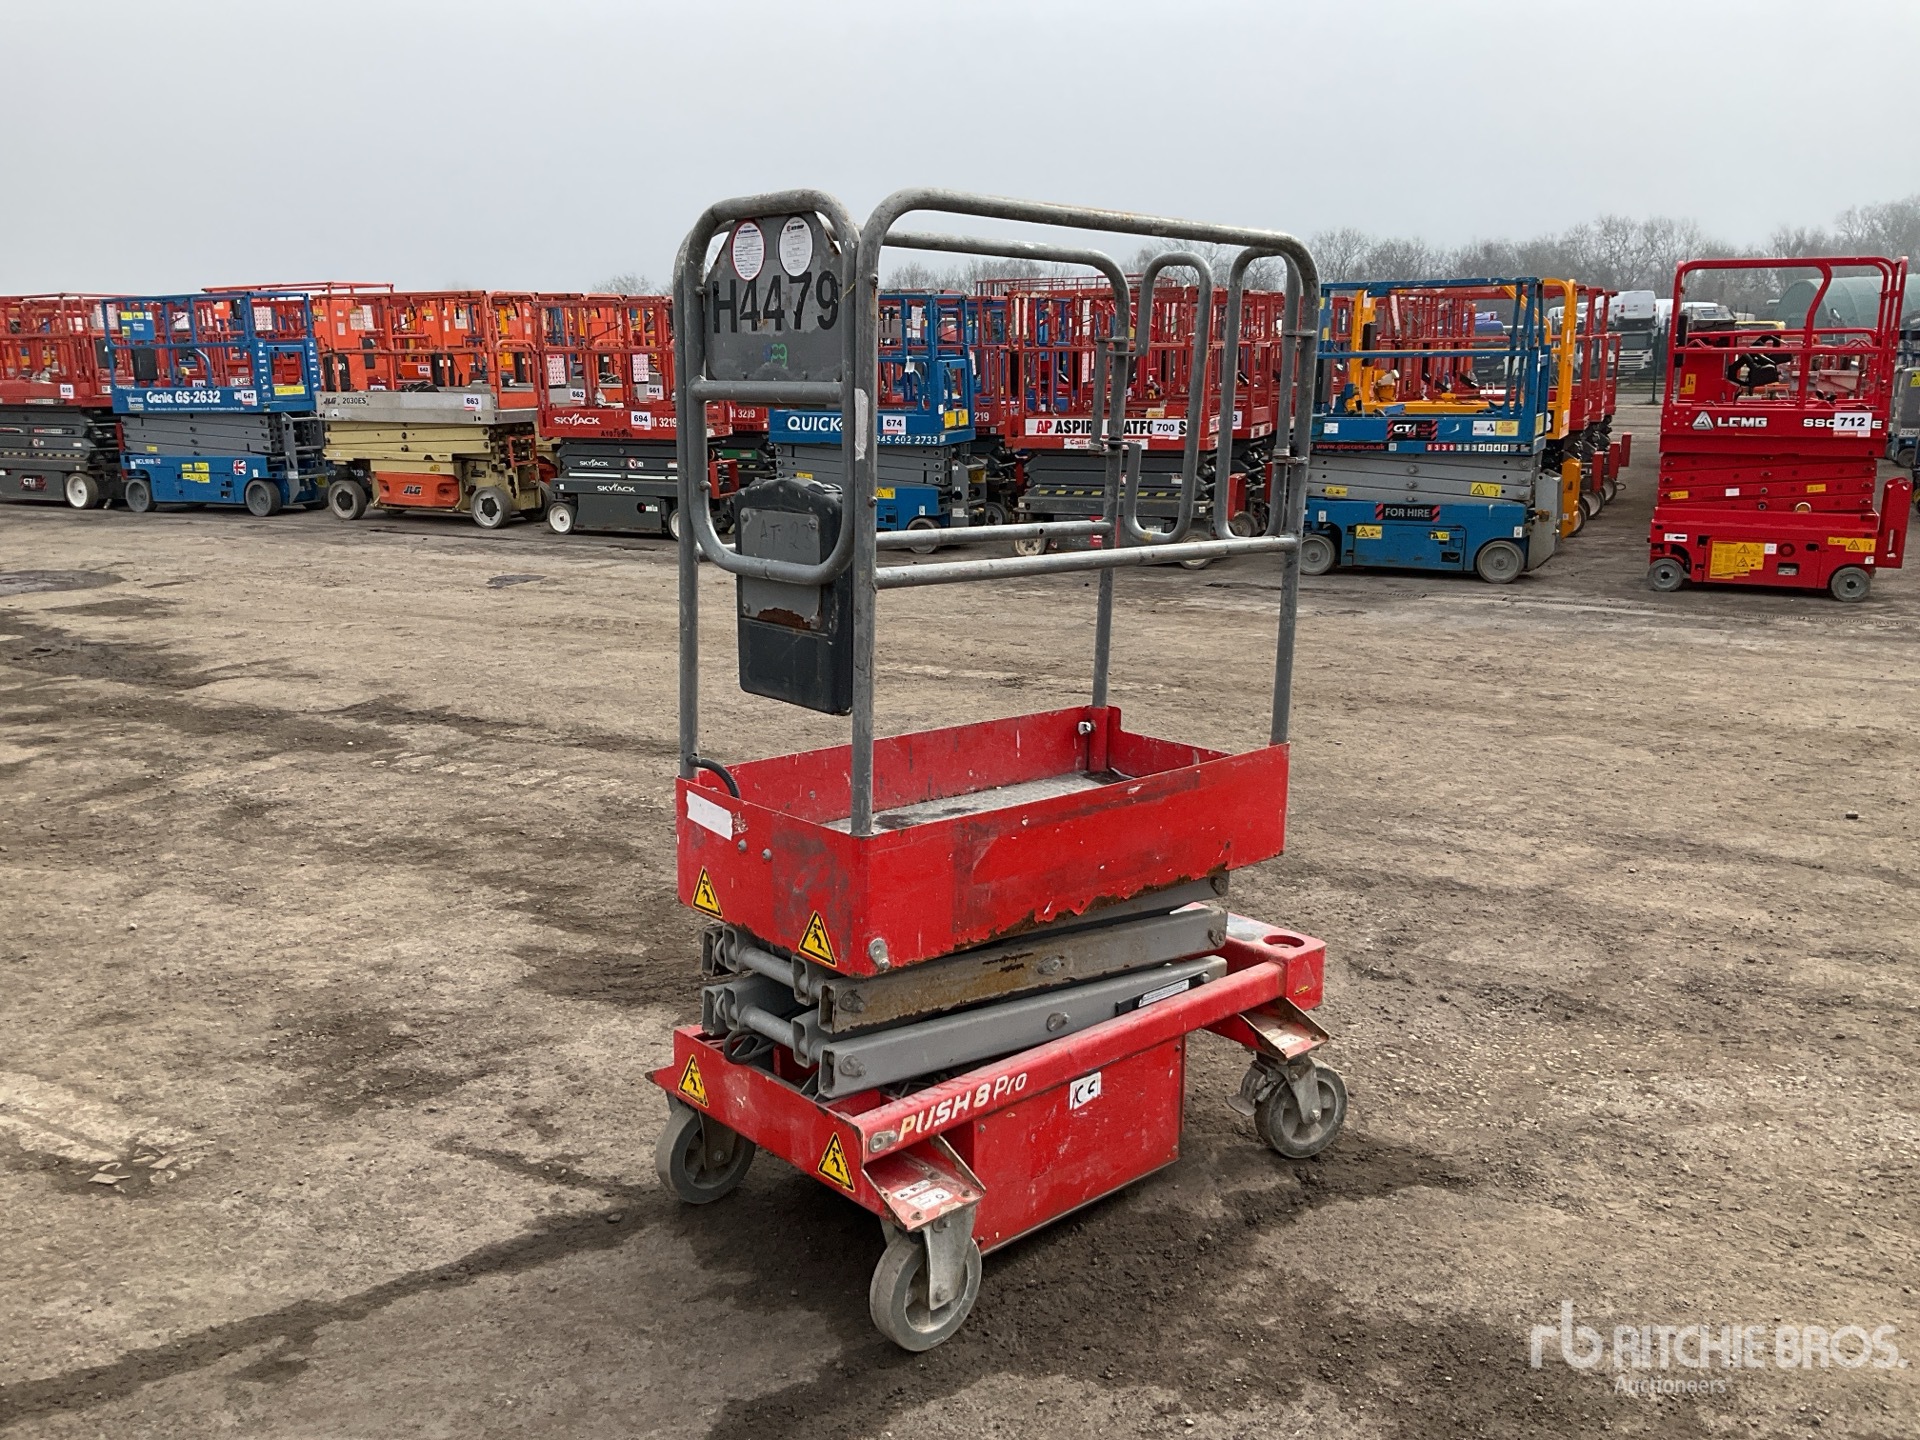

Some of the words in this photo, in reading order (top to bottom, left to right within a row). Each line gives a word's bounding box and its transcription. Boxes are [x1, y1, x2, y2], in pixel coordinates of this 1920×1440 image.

[712, 271, 838, 334] H4479
[146, 391, 173, 404] Genie
[175, 390, 221, 404] GS-2632
[323, 397, 337, 405] JLG
[466, 397, 479, 405] 663
[553, 413, 600, 425] SKYJACK
[633, 414, 648, 423] 694
[659, 417, 677, 427] 3219
[974, 412, 990, 422] 219
[1839, 417, 1866, 427] 712
[787, 415, 843, 432] QUICK
[886, 419, 902, 427] 674
[1055, 420, 1092, 434] ASPIR
[1156, 423, 1175, 432] 700
[1392, 423, 1416, 438] GTA
[894, 436, 911, 444] 602
[914, 436, 938, 445] 2733
[579, 459, 609, 467] SKYJACK
[404, 485, 422, 495] JLG
[597, 483, 636, 493] SKYJACK
[1385, 507, 1405, 518] FOR
[1407, 508, 1430, 518] HIRE
[898, 1091, 971, 1142] PUSH
[973, 1083, 990, 1108] 8
[993, 1073, 1028, 1100] Pro
